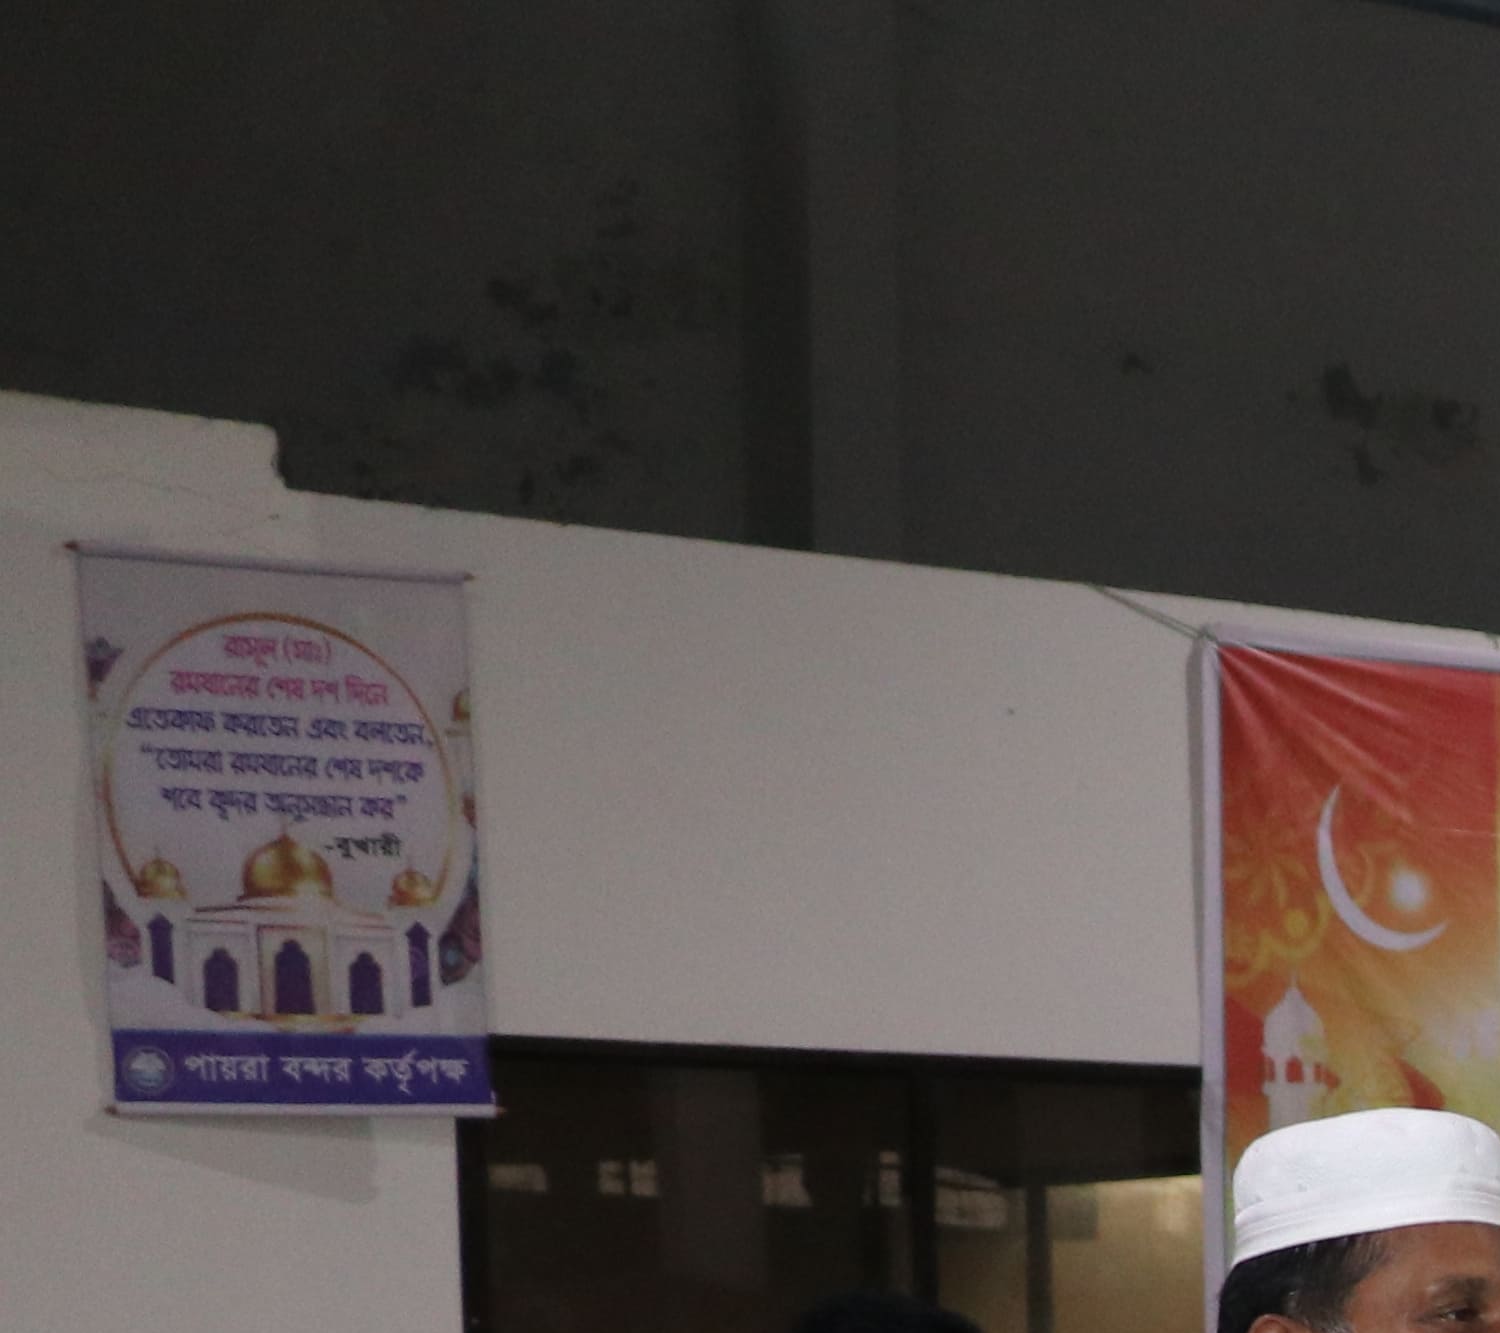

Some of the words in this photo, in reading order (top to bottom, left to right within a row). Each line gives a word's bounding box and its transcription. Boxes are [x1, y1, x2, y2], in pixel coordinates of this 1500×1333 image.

[266, 676, 305, 700] শেষ
[311, 679, 340, 703] দশ
[345, 674, 389, 705] দিনে
[221, 712, 300, 738] করতেন
[306, 717, 348, 741] এবং
[324, 756, 363, 780] শেষ
[161, 787, 202, 812] শবে
[184, 1054, 270, 1083] পায়রা
[280, 1056, 353, 1083] বন্দর
[362, 1049, 470, 1095] কর্তৃপক্ষ
